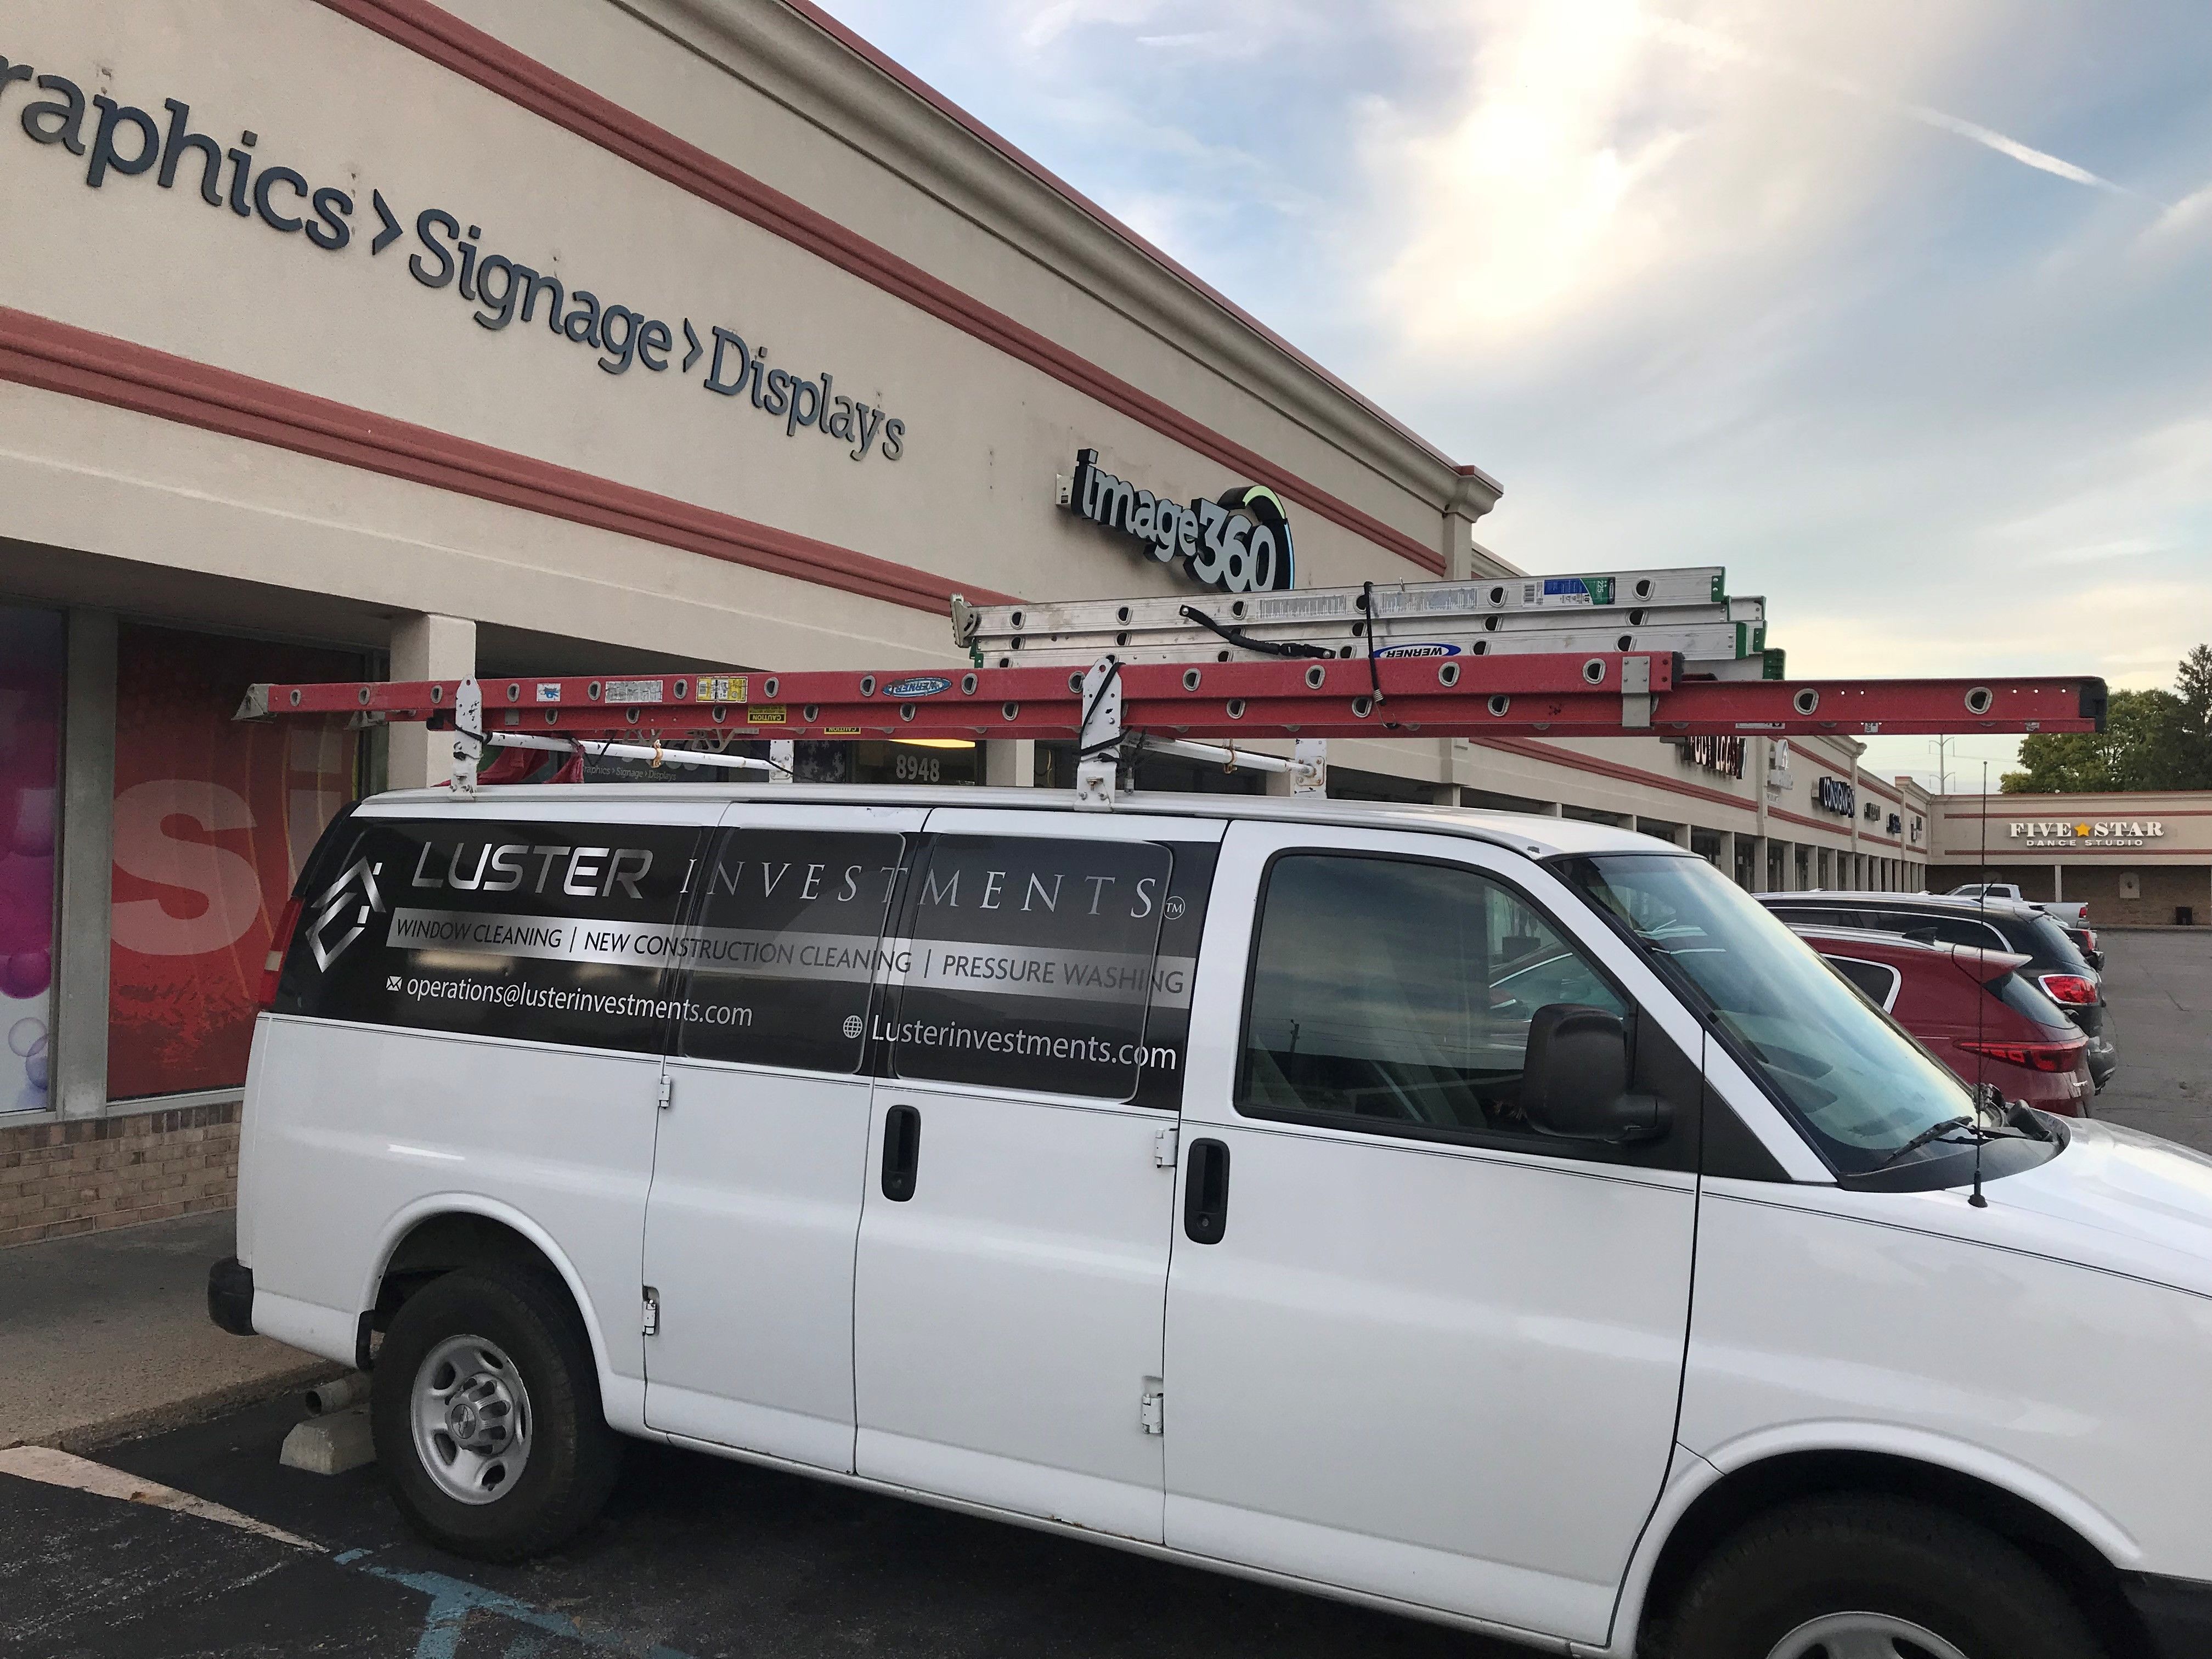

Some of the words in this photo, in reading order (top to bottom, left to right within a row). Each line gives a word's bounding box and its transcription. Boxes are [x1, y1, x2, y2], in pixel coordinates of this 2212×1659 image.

[409, 208, 673, 375] Signage
[704, 325, 906, 461] Displays
[1071, 448, 1277, 592] image360
[1386, 647, 1442, 658] WERNER
[616, 767, 644, 779] Signage
[648, 770, 676, 782] Displays
[896, 754, 940, 782] 8948
[2010, 822, 2072, 838] FIVE
[2094, 821, 2164, 837] STAR
[411, 842, 654, 900] LUSTER
[680, 858, 1158, 919] INVESTMENTS
[397, 918, 472, 941] WINDOW
[473, 923, 562, 948] CLEANING
[584, 932, 631, 953] NEW
[634, 934, 795, 966] CONSTRUCTION
[800, 946, 912, 973] CLEANING
[943, 955, 1056, 983] PRESSURE
[1063, 963, 1184, 994] WASHING
[407, 975, 753, 1026] operations@lusterinvestments.com
[872, 1015, 1176, 1070] Lusterinvestments.com
